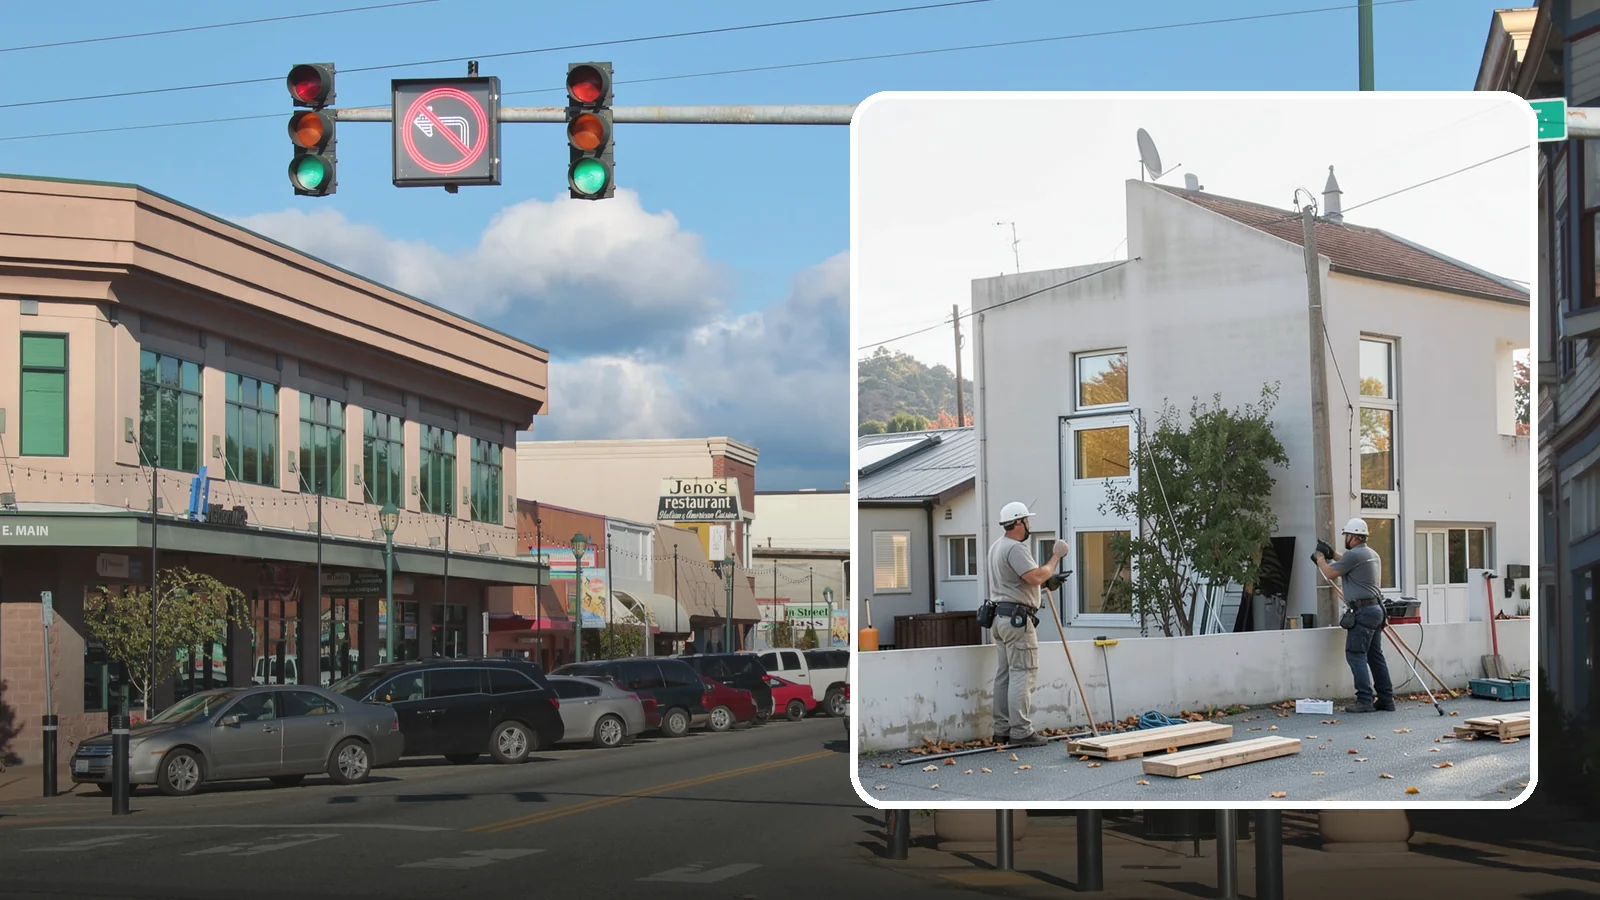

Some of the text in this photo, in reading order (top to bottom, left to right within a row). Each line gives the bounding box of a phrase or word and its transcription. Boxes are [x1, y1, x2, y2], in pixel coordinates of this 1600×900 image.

[669, 480, 728, 495] Jeno's
[665, 496, 731, 509] restaurant
[658, 509, 681, 519] Italian
[686, 509, 714, 519] American
[715, 509, 738, 519] Cuisine
[2, 525, 49, 536] E. MAIN
[797, 607, 829, 617] Street
